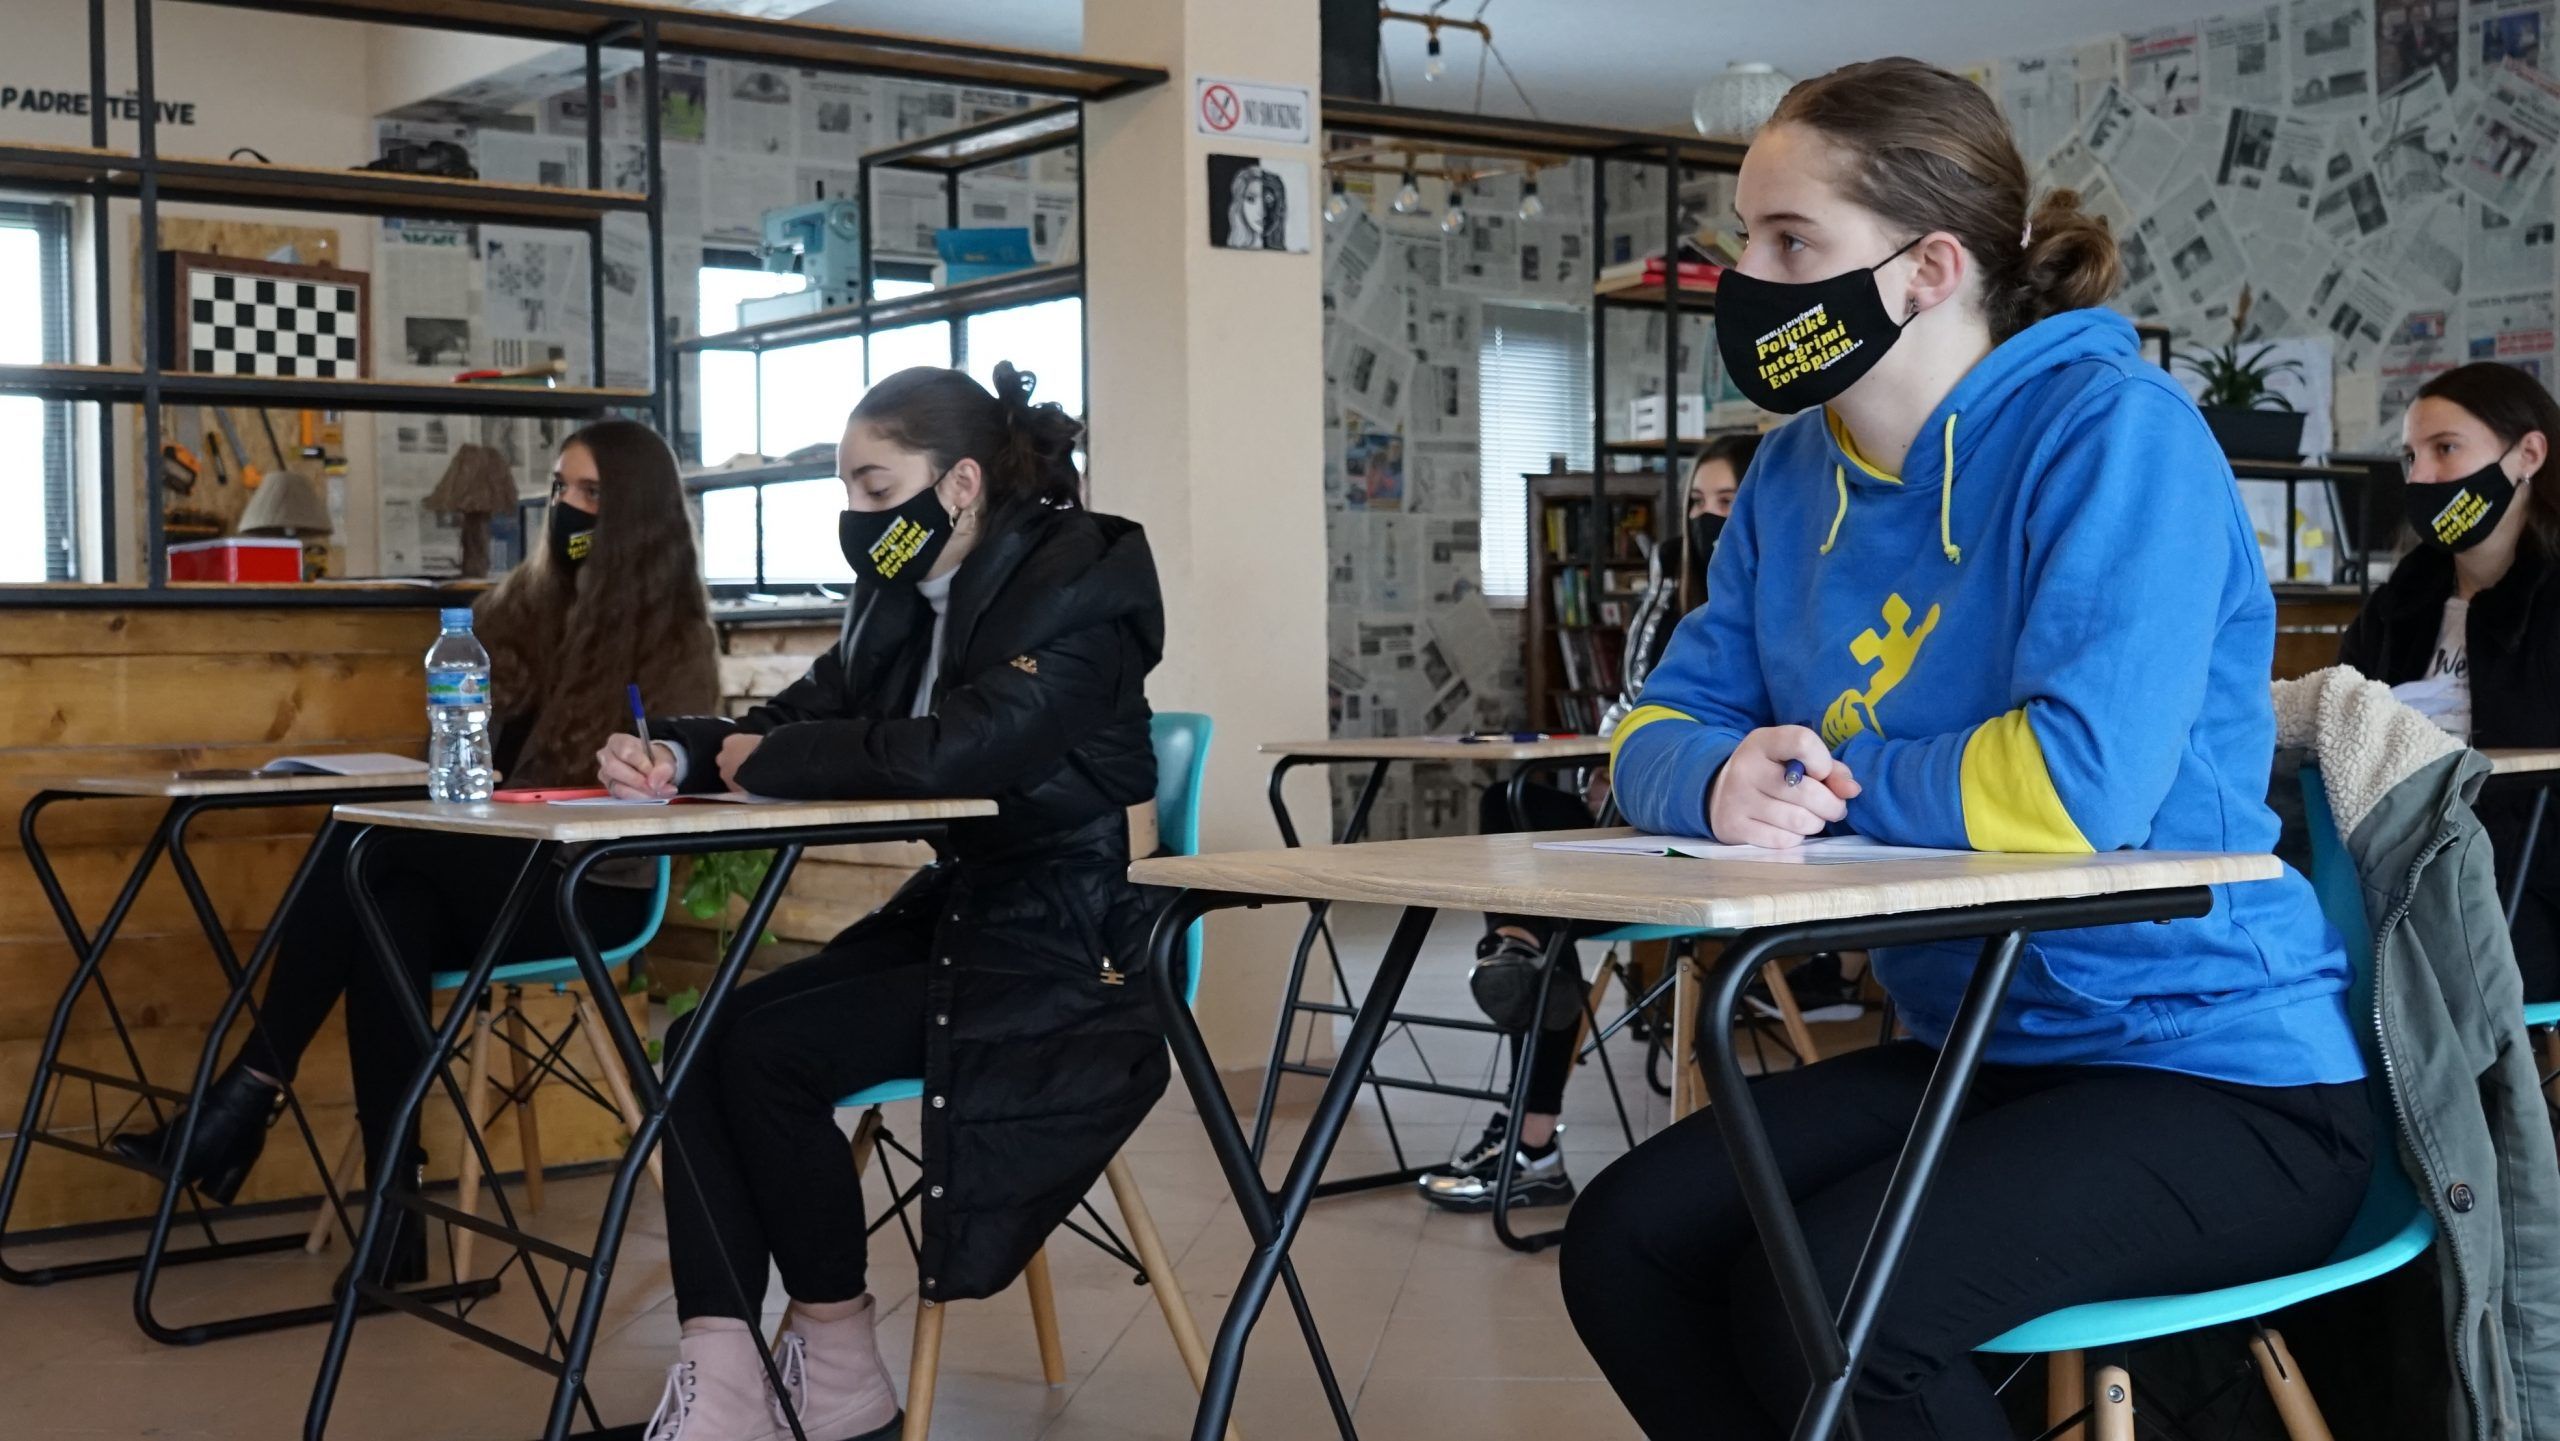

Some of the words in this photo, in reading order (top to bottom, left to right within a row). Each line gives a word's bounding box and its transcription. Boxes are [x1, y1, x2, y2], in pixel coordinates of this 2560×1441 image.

[1, 87, 196, 125] PADRETËIVE
[1758, 320, 1847, 380] Integrimi
[1768, 337, 1854, 390] Evropian
